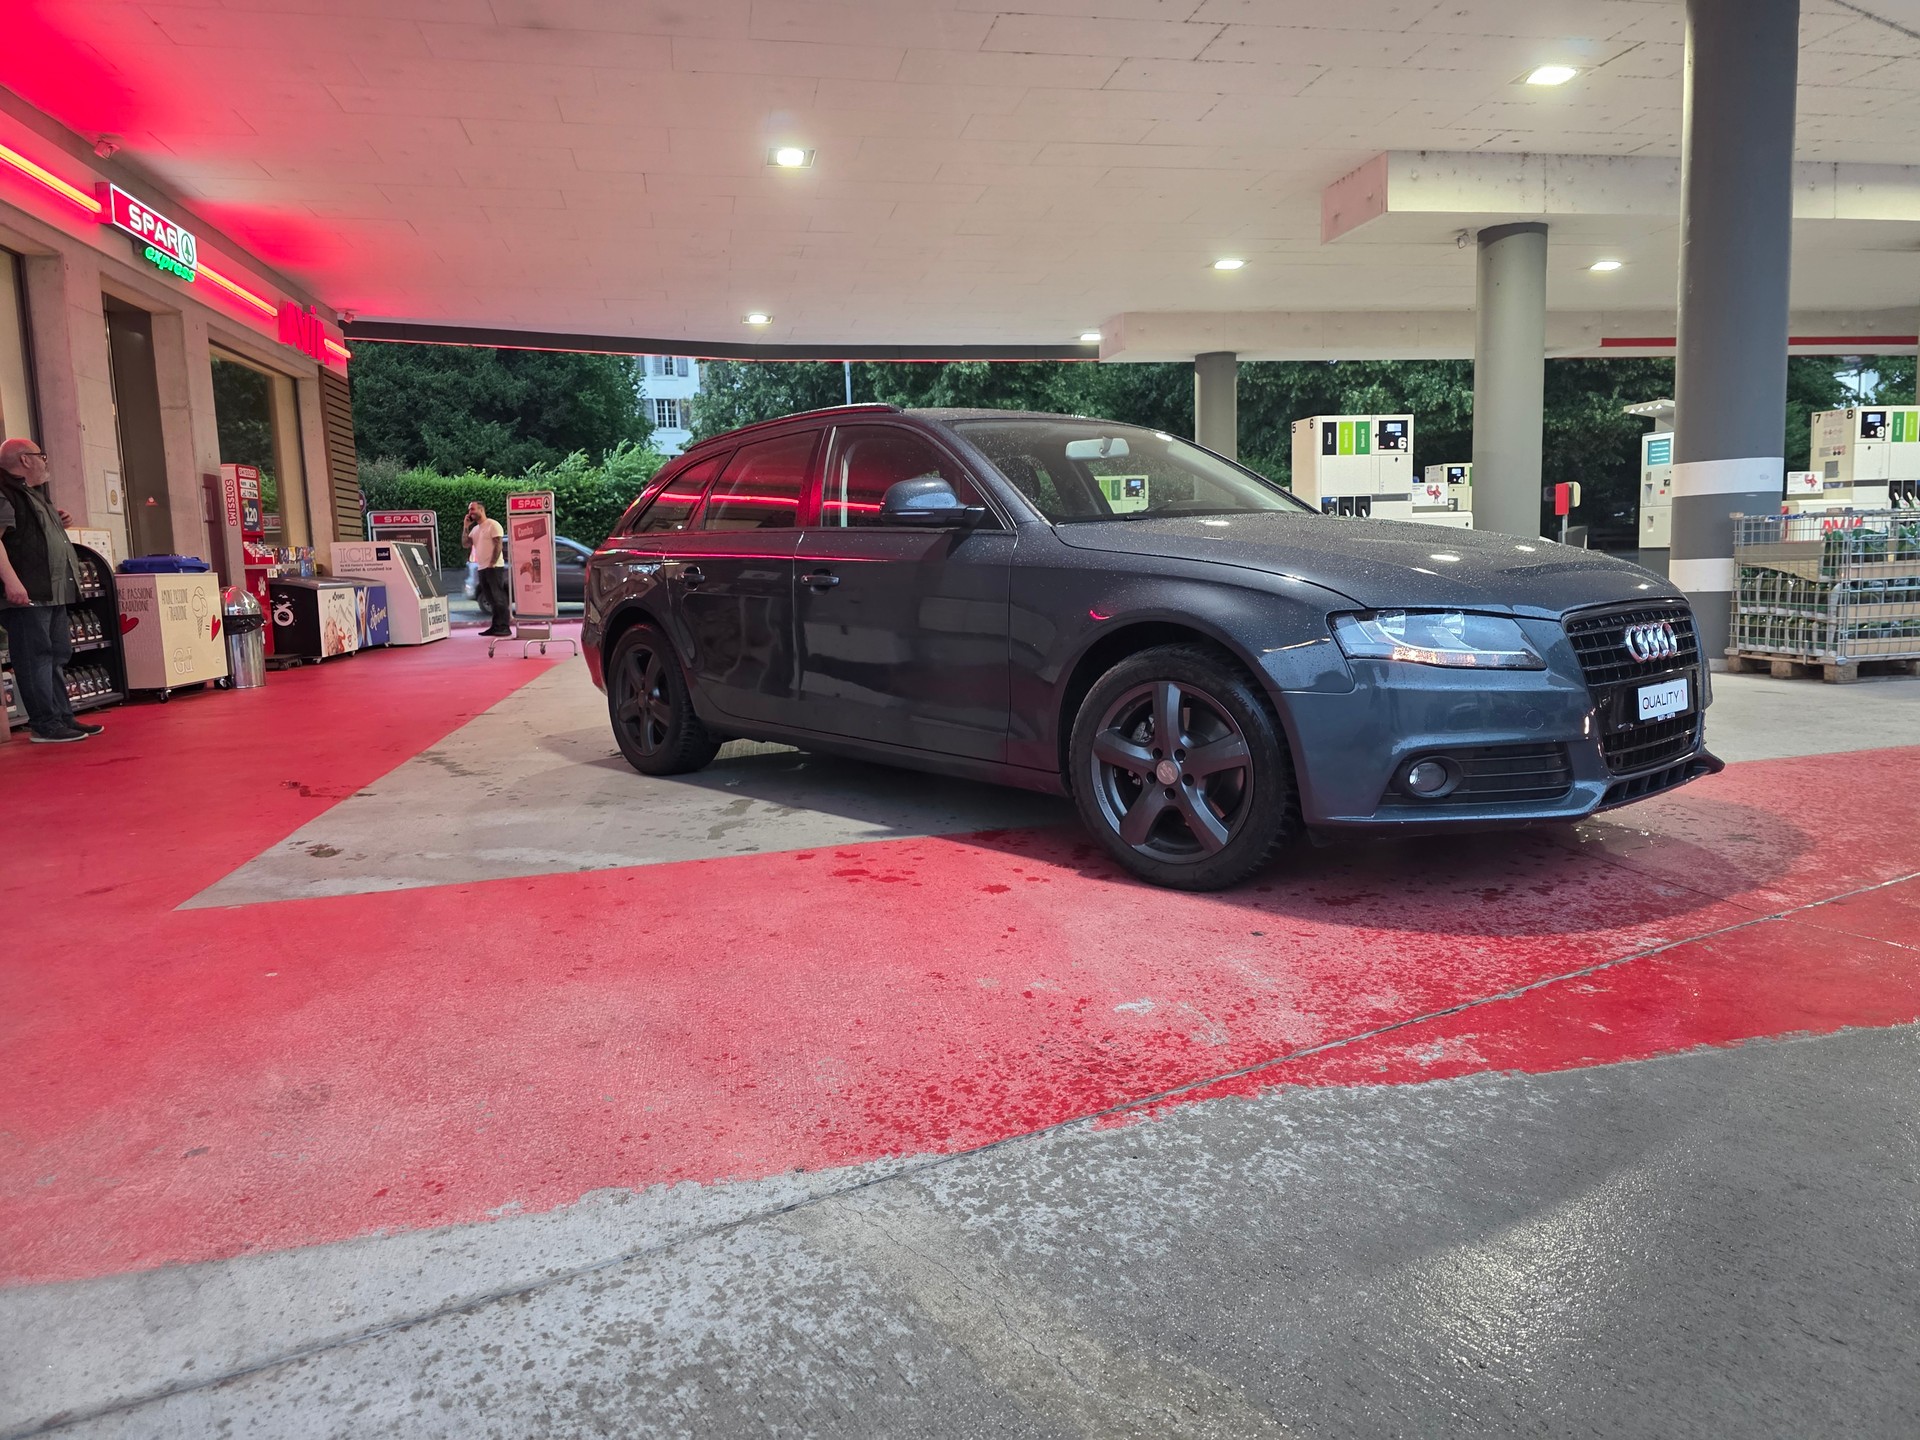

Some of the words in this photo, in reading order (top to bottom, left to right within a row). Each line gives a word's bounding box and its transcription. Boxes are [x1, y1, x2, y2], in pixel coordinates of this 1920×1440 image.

[128, 203, 179, 253] SPAR
[144, 246, 196, 283] express
[1814, 413, 1821, 424] 7
[1846, 409, 1854, 420] 8
[1292, 422, 1297, 434] 5
[1309, 418, 1314, 430] 6
[1876, 426, 1885, 438] 8
[1397, 437, 1407, 449] 6
[1458, 476, 1464, 484] 4
[225, 479, 237, 526] SWISSLOS
[517, 499, 542, 509] SPAR
[383, 515, 419, 523] SPAR
[517, 526, 534, 538] Combo
[338, 547, 374, 563] ICE
[127, 587, 153, 600] PASSIONE
[1642, 690, 1680, 710] QUALITY
